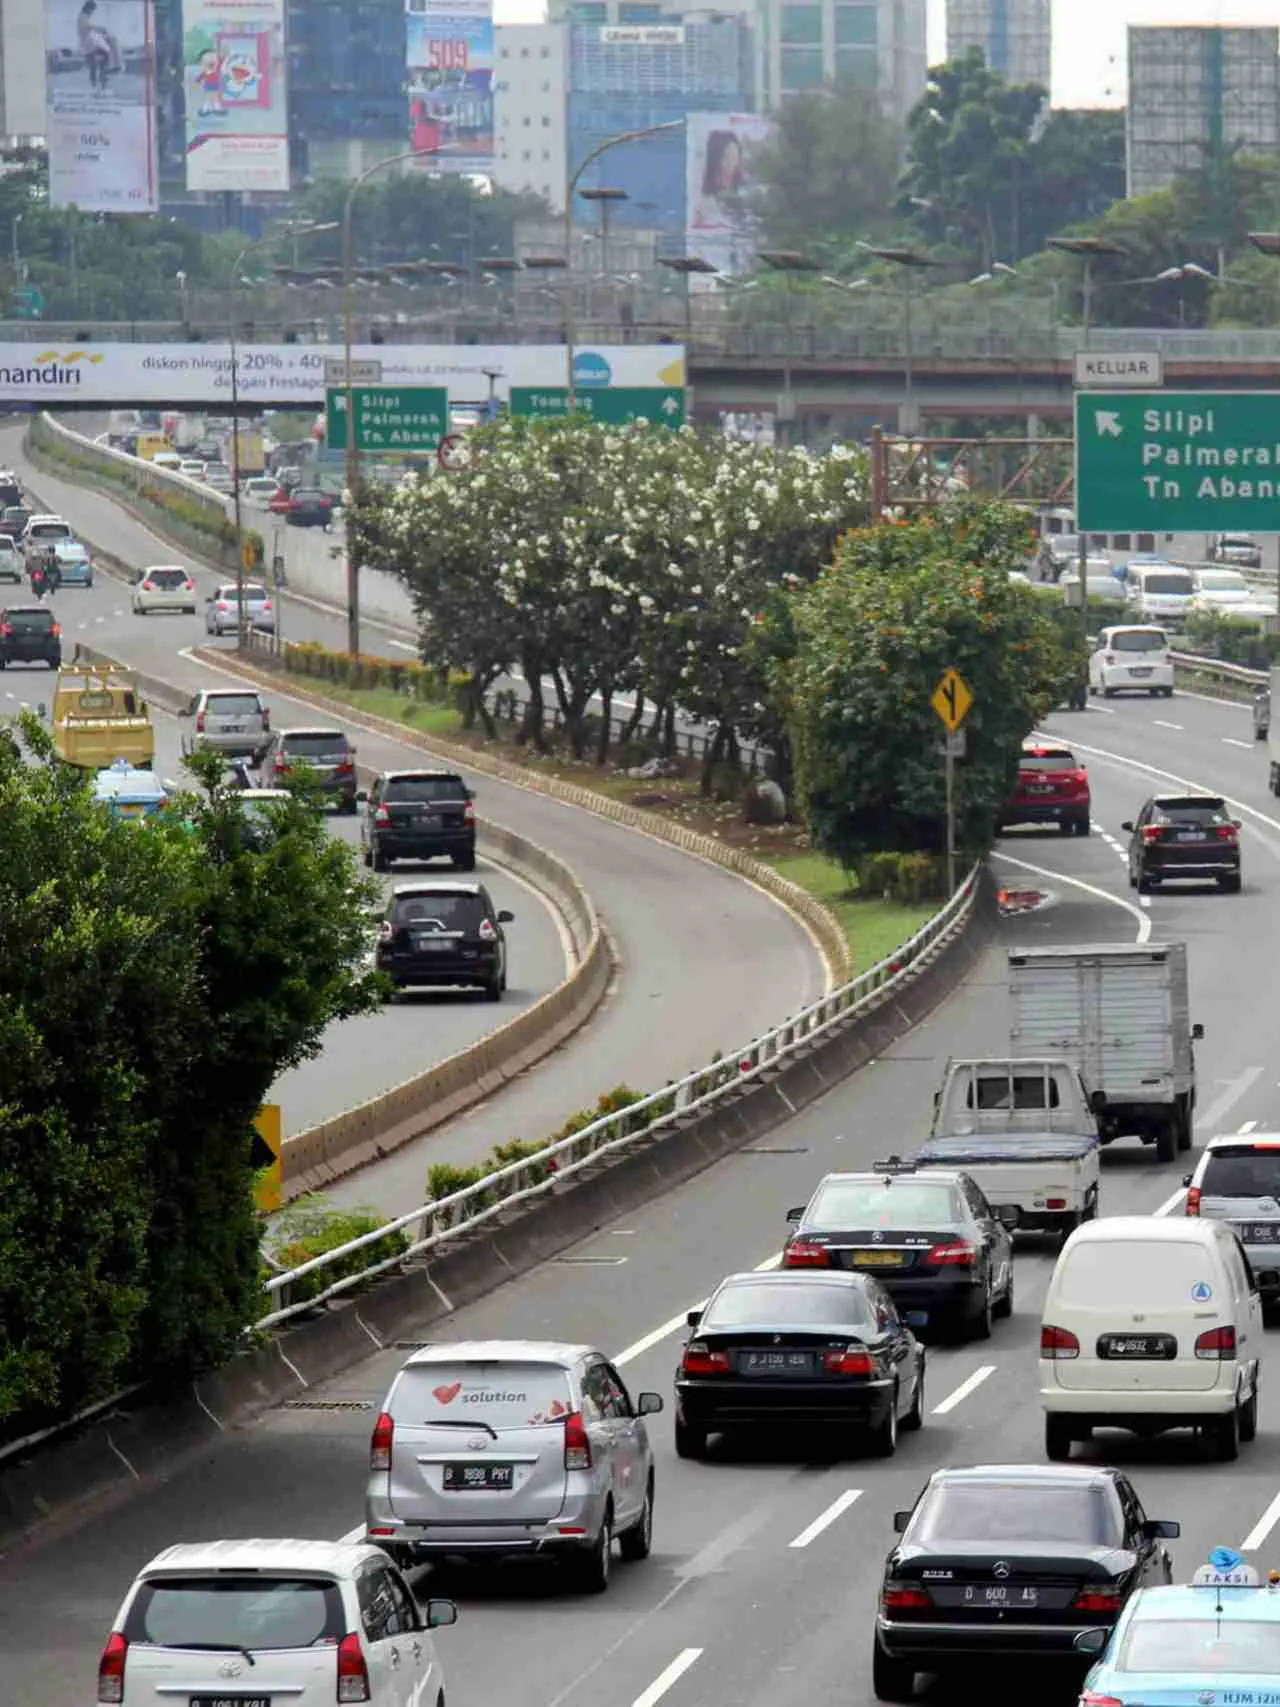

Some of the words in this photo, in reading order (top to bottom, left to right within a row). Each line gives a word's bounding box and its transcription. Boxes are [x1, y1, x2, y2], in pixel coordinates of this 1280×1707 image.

[142, 356, 189, 369] diskon
[243, 354, 283, 369] 20%
[1086, 361, 1148, 374] KELUAR
[361, 394, 400, 412] Slipi
[1143, 410, 1214, 436] Slipi
[1142, 476, 1180, 497] Tn
[462, 1391, 527, 1403] solution
[445, 1468, 454, 1480] B
[1204, 1574, 1249, 1584] TAKSI
